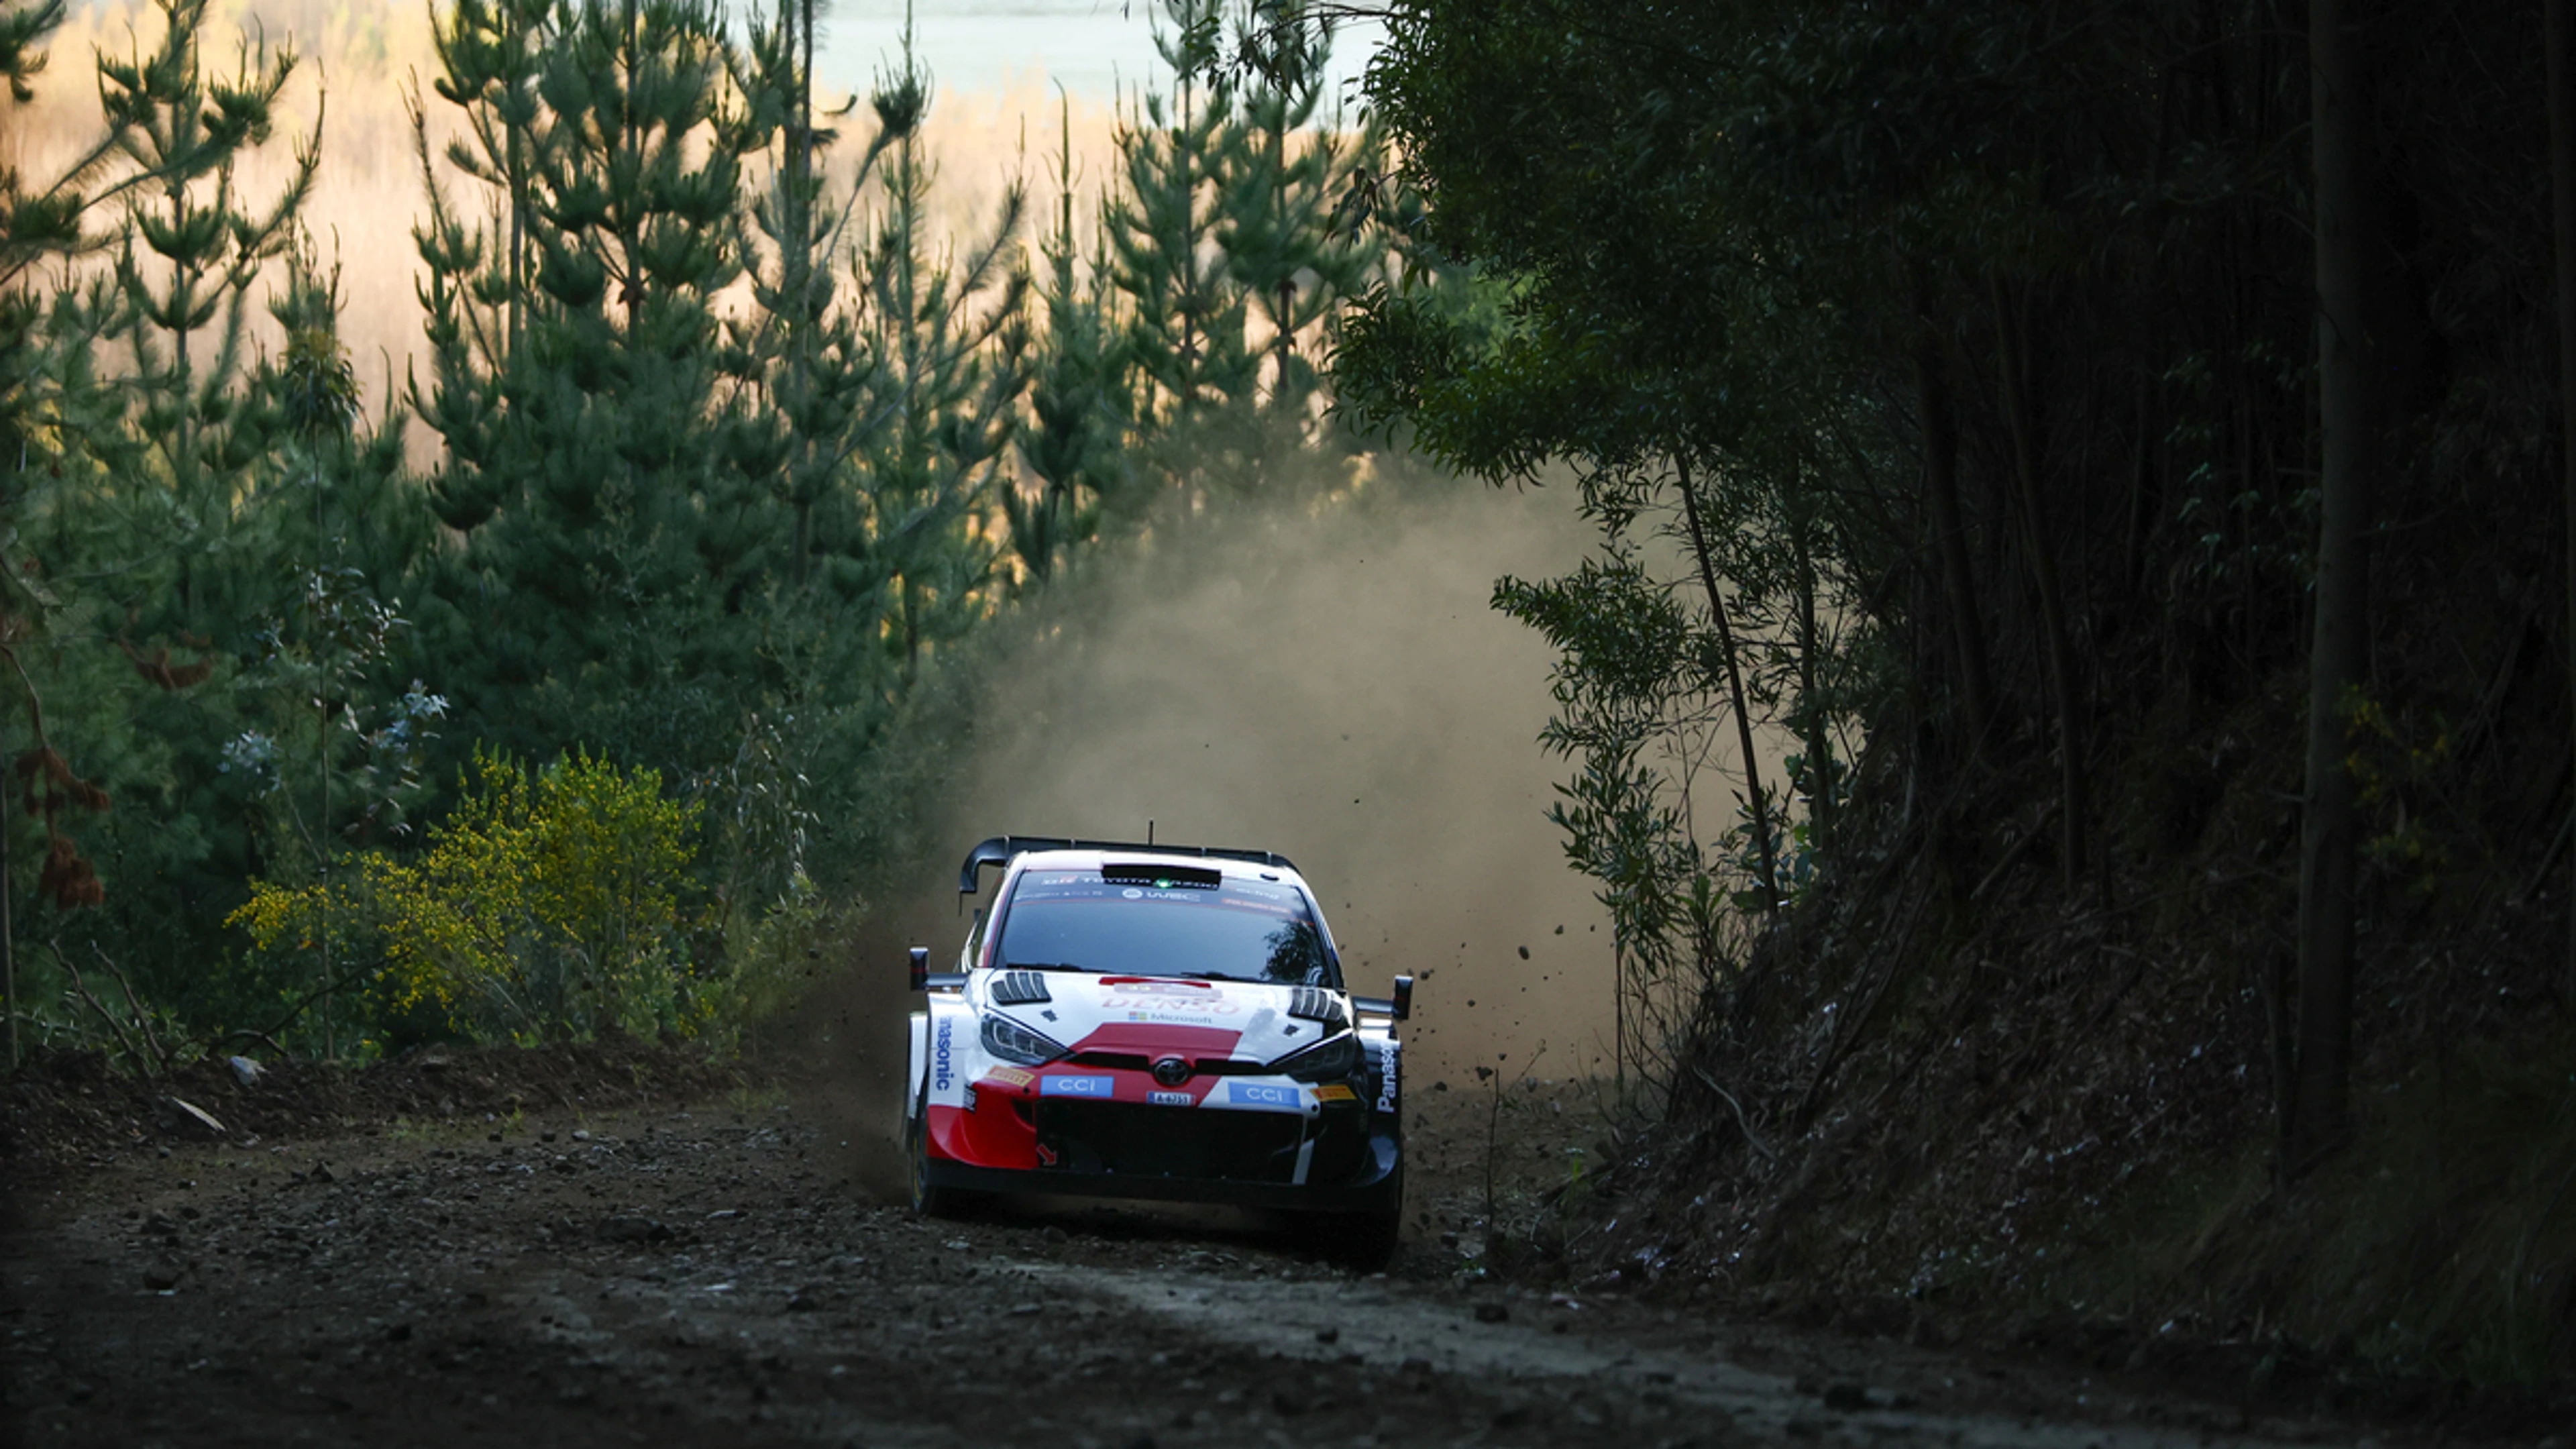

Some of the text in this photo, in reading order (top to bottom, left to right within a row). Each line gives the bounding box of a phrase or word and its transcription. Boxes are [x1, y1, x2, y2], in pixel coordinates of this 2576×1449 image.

[1146, 892, 1201, 902] WRC
[1102, 997, 1241, 1015] DENSO
[1150, 1012, 1213, 1024] Microsoft
[1058, 1078, 1096, 1091] CCI
[1246, 1087, 1283, 1102] CCI
